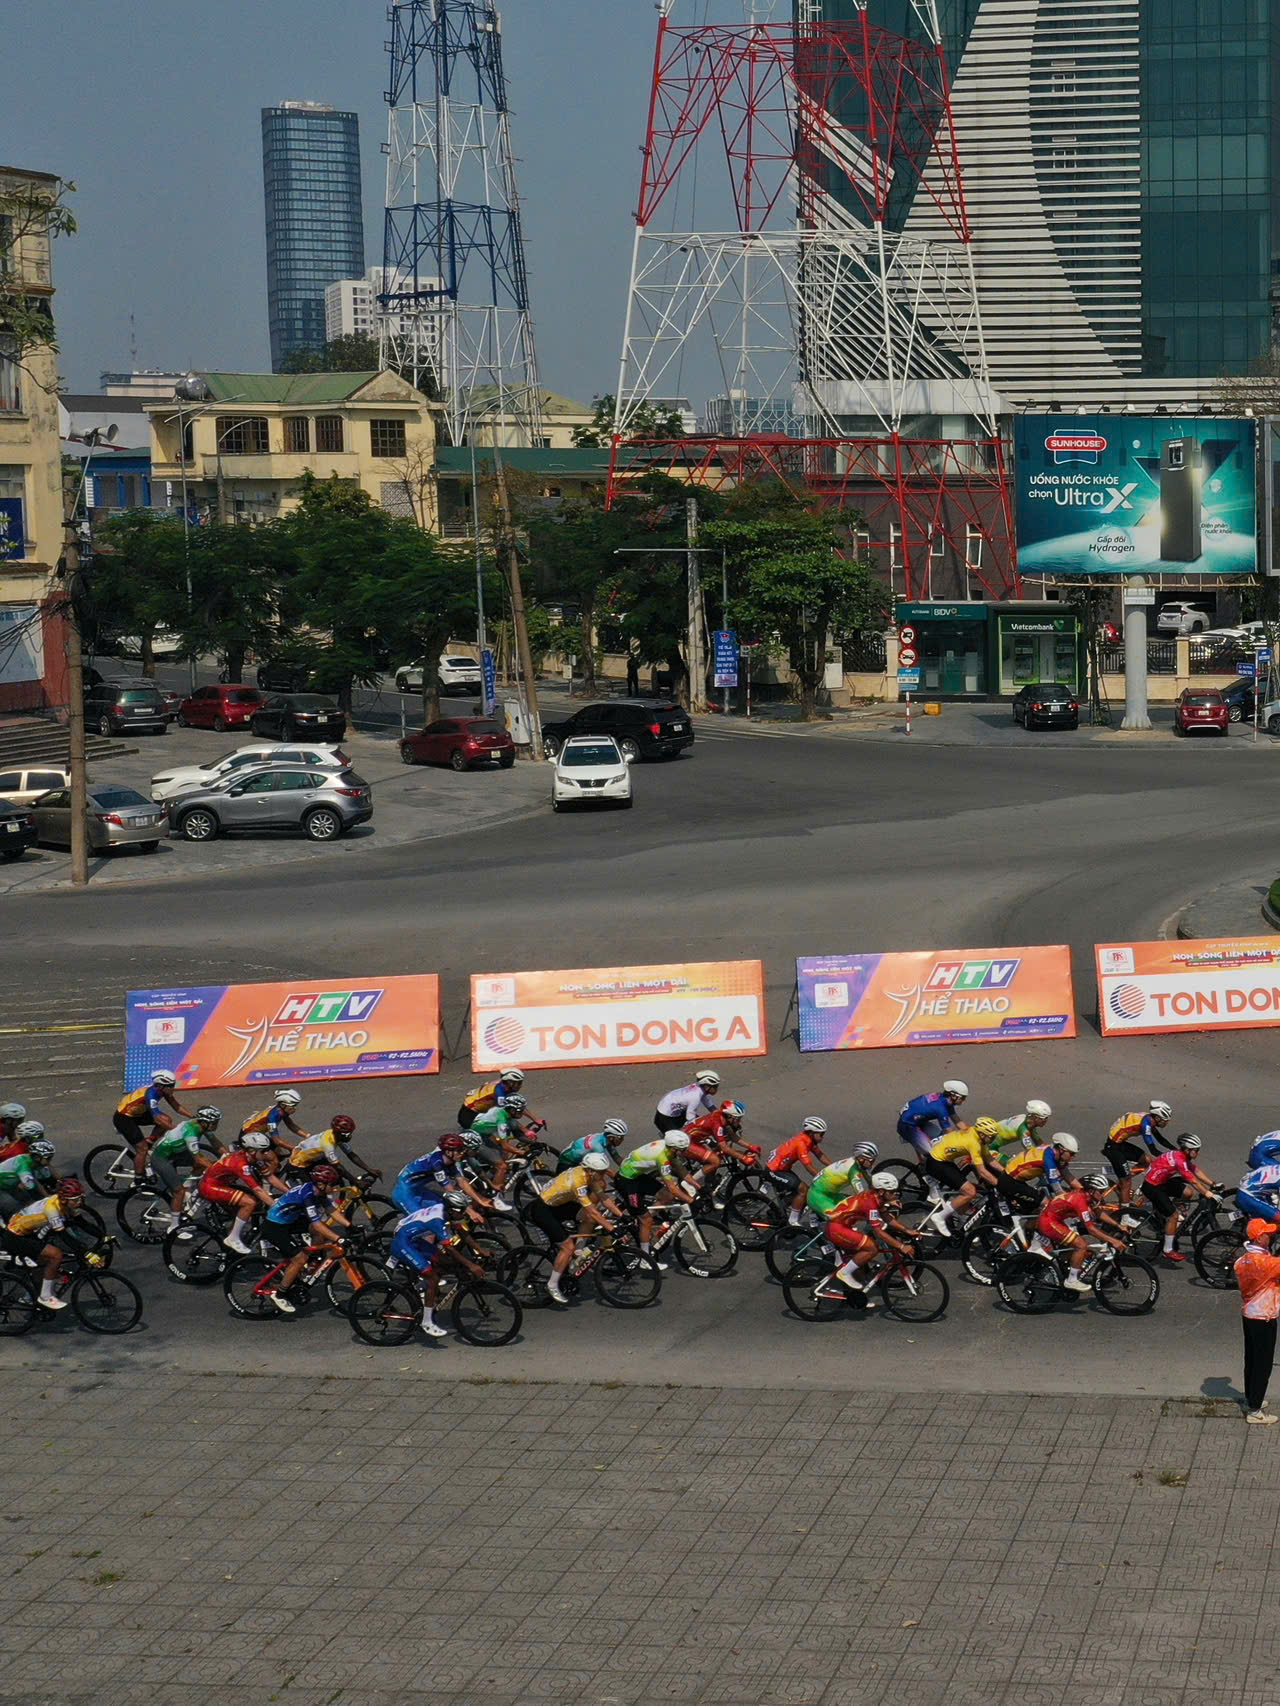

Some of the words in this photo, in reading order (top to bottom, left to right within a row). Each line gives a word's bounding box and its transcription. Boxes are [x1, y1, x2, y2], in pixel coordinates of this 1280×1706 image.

[1050, 439, 1102, 448] SUNHOUSE
[1030, 472, 1060, 485] UỐNG
[1061, 474, 1091, 485] NƯỚC
[1028, 489, 1053, 500] chọn
[1089, 543, 1135, 552] Hydrogen
[1011, 623, 1054, 631] Vietcombank
[928, 963, 1014, 987] HTV
[277, 993, 377, 1022] HTV
[954, 997, 1010, 1015] THAO
[1150, 990, 1218, 1017] TON
[305, 1030, 369, 1050] THAO
[531, 1023, 607, 1051] TON
[616, 1017, 720, 1047] DONG
[725, 1015, 752, 1041] A
